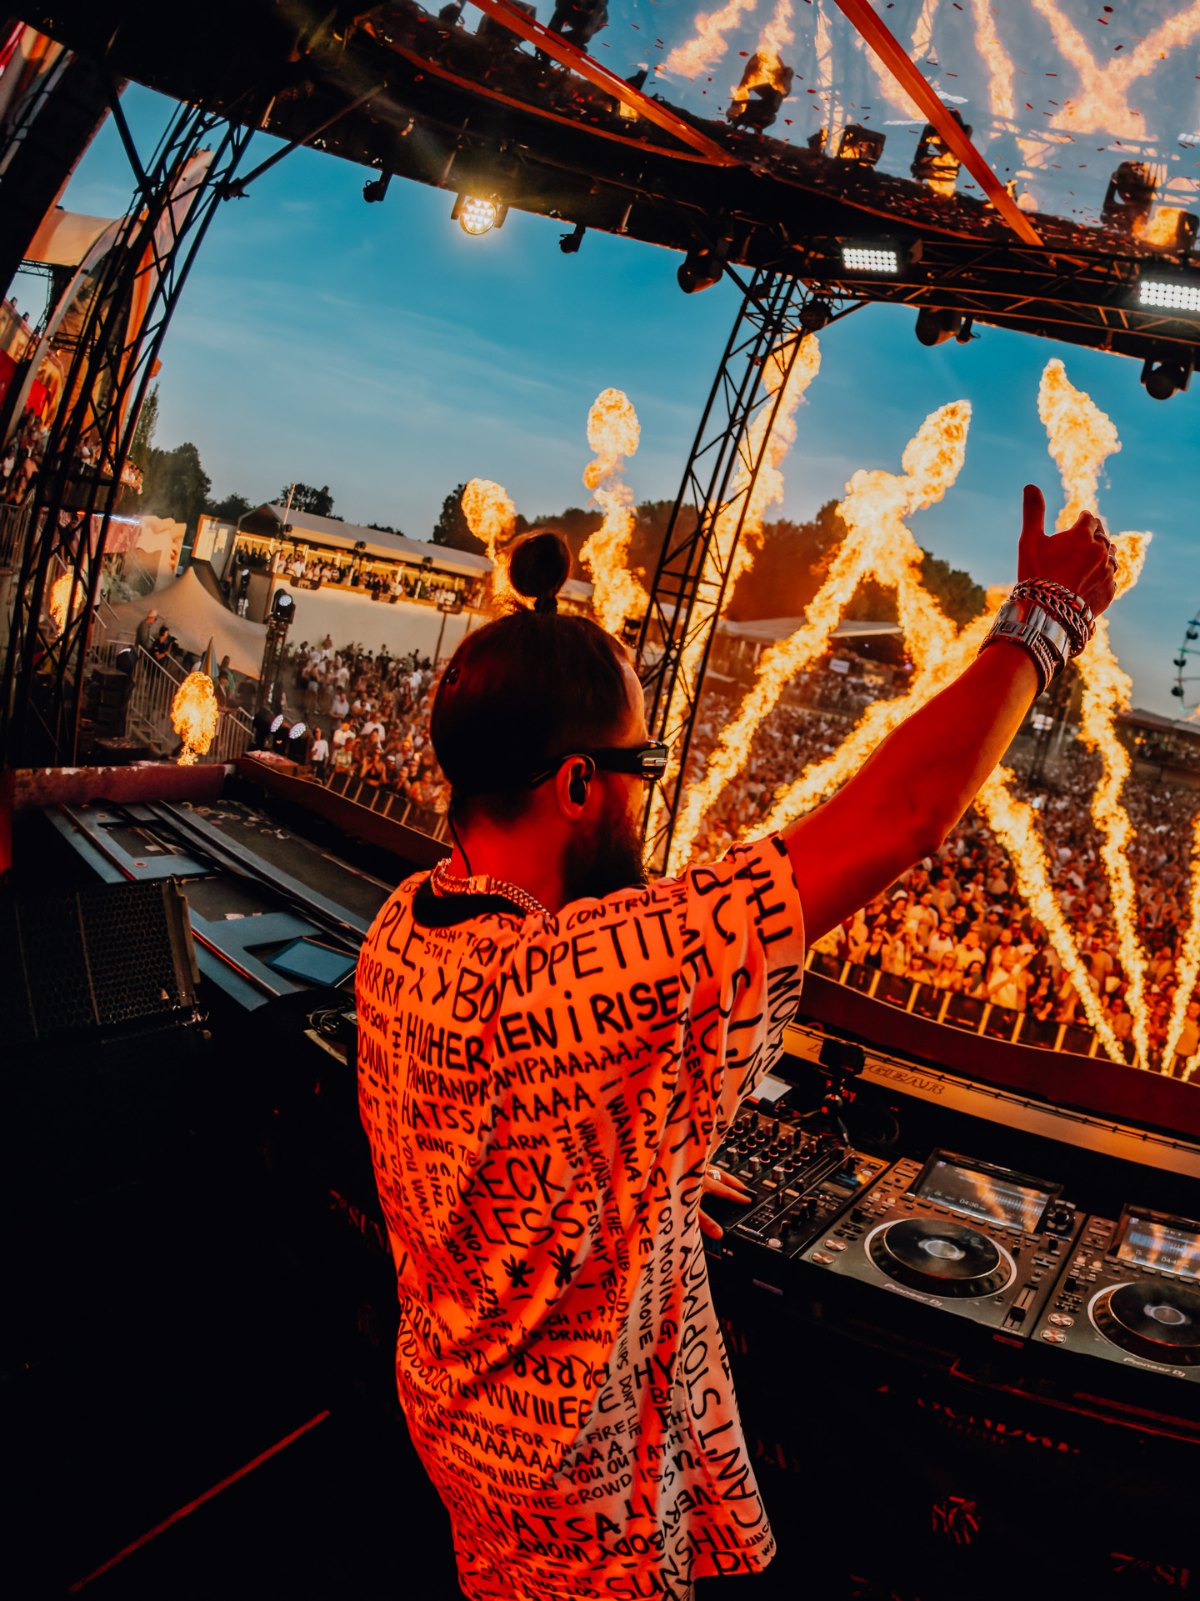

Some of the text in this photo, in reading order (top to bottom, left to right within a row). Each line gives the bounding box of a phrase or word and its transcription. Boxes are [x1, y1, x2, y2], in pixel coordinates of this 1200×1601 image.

[589, 975, 681, 1036] RISE
[402, 1134, 419, 1173] YOU
[410, 1178, 437, 1231] WANT
[468, 1198, 586, 1250] LESS
[579, 1198, 603, 1239] FOR
[605, 1093, 643, 1183] WANNA
[639, 1289, 655, 1351] MOVE
[649, 1167, 674, 1235] STOP
[590, 1237, 614, 1265] MY
[682, 1322, 723, 1422] STOP
[511, 1425, 549, 1450] FOR
[562, 1465, 605, 1485] YOU
[606, 1445, 641, 1475] OUT
[564, 1472, 633, 1506] CROWD
